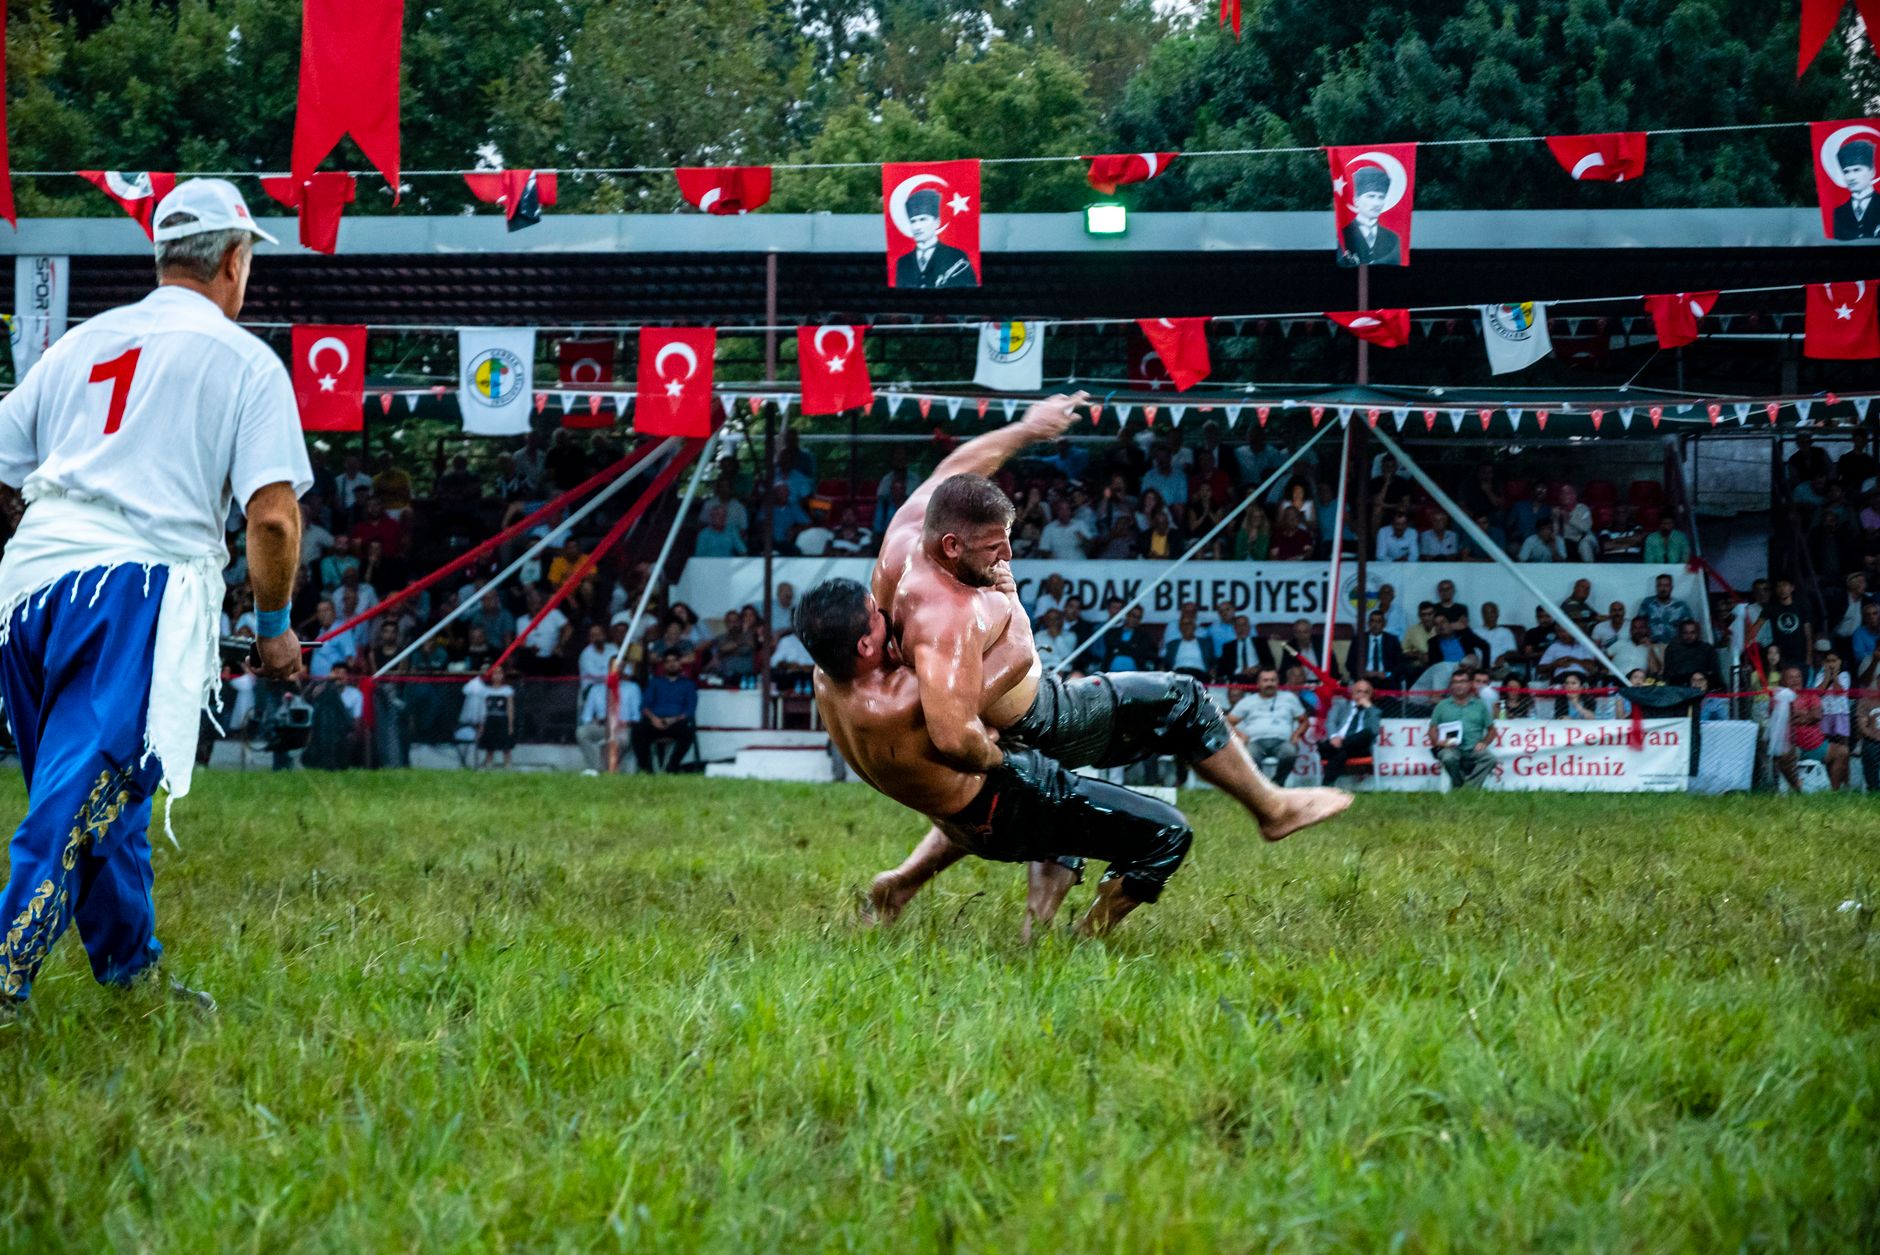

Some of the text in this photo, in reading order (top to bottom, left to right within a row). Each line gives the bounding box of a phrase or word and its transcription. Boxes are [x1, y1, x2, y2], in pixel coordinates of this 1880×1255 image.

[35, 257, 49, 310] SPOR
[88, 347, 142, 434] 1
[1154, 571, 1329, 613] BELEDİYESİ
[1513, 754, 1626, 777] Geldiniz
